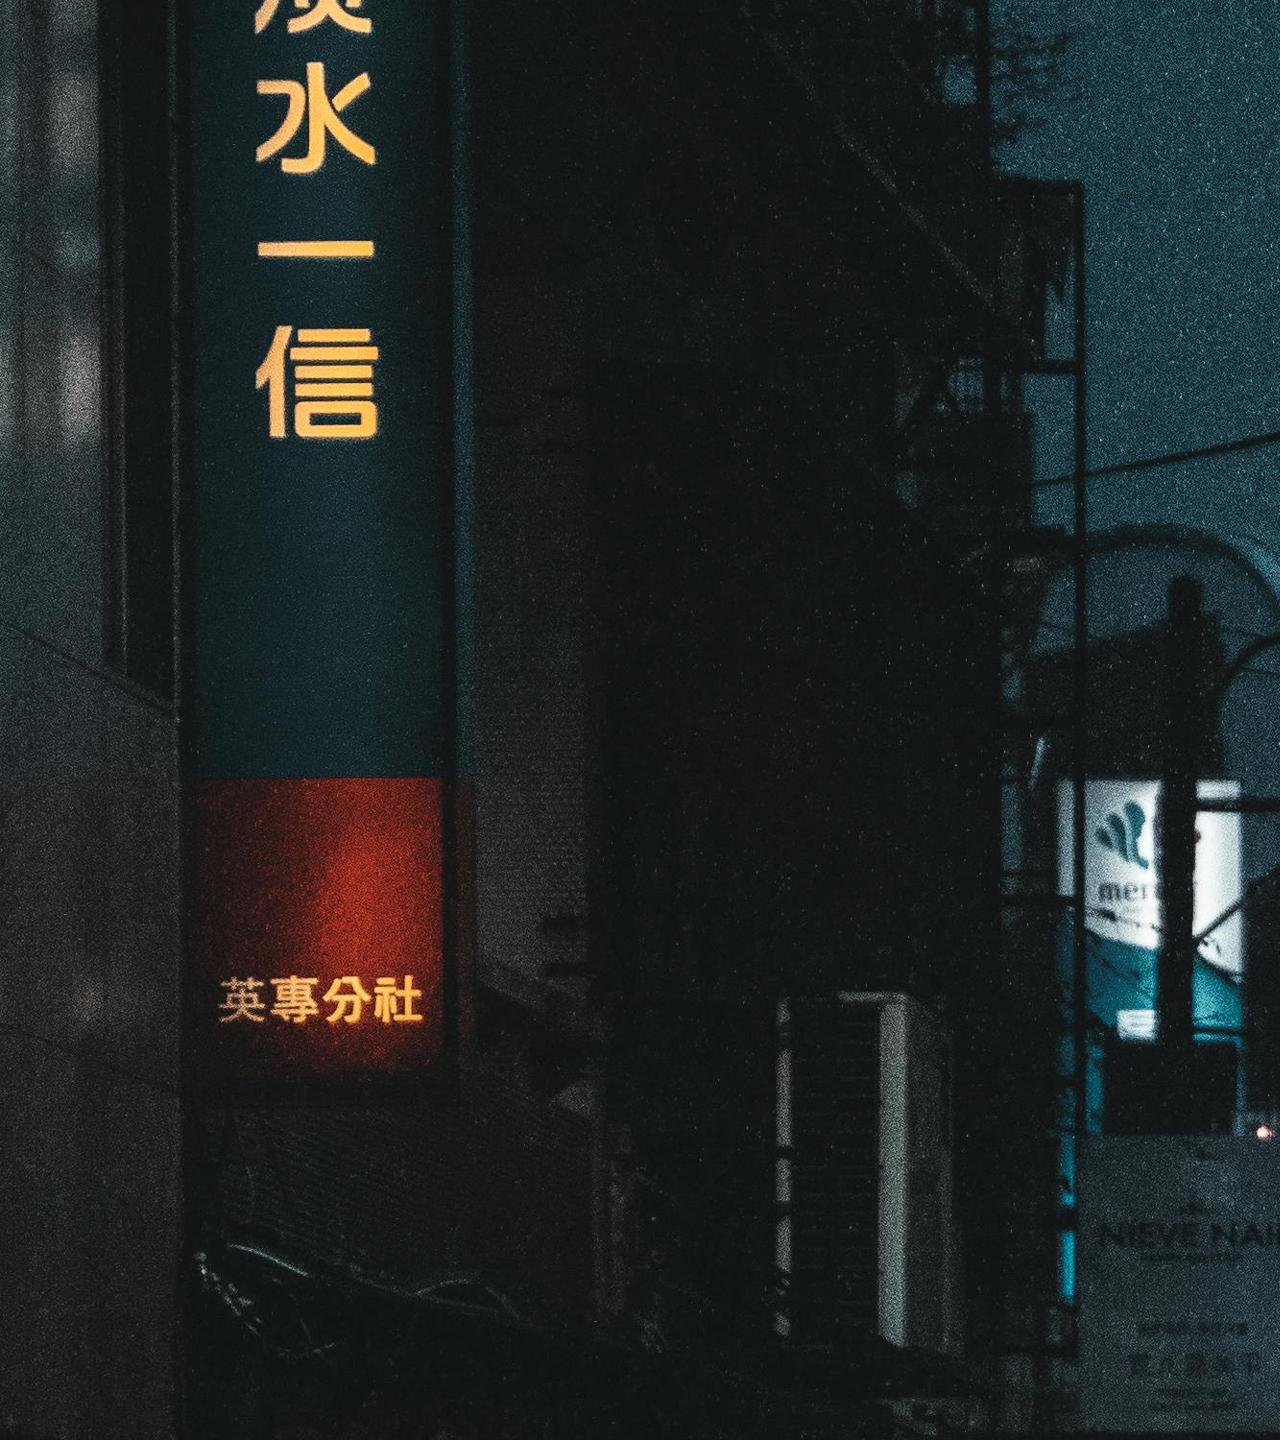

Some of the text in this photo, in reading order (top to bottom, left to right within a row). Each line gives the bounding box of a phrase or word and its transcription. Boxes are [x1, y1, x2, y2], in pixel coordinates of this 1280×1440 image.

[218, 975, 425, 1025] 英專分社
[1098, 1221, 1198, 1248] NIEVE
